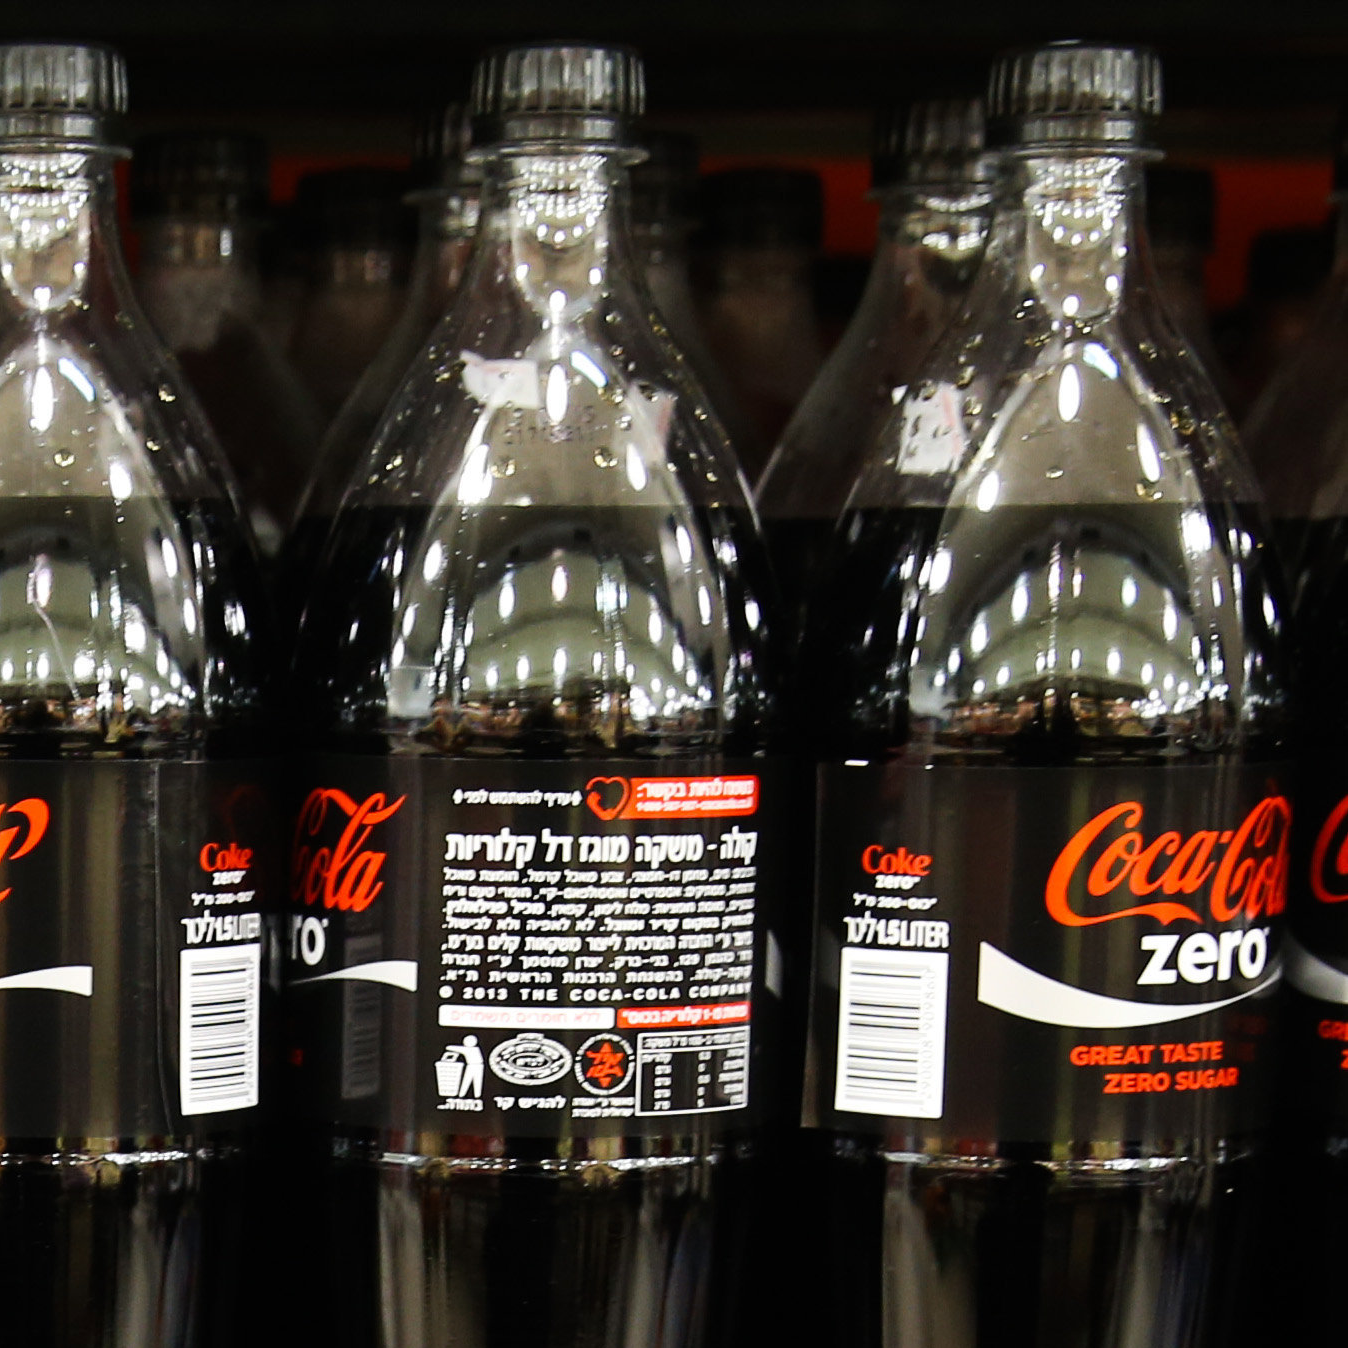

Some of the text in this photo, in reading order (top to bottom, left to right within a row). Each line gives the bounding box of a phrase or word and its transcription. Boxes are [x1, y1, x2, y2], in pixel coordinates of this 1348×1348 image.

[200, 843, 251, 872] Coke
[445, 828, 536, 869] קלוריות
[542, 828, 573, 862] דל
[578, 835, 630, 863] מוגז
[635, 835, 703, 869] משקה
[862, 845, 933, 877] Coke
[1136, 926, 1269, 986] zero
[463, 987, 507, 1000] 2013
[520, 989, 557, 1001] THE
[570, 987, 680, 1001] COCA-COLA
[1069, 1039, 1224, 1067] GREAT TASTE
[1103, 1066, 1240, 1095] ZERO SUGAR
